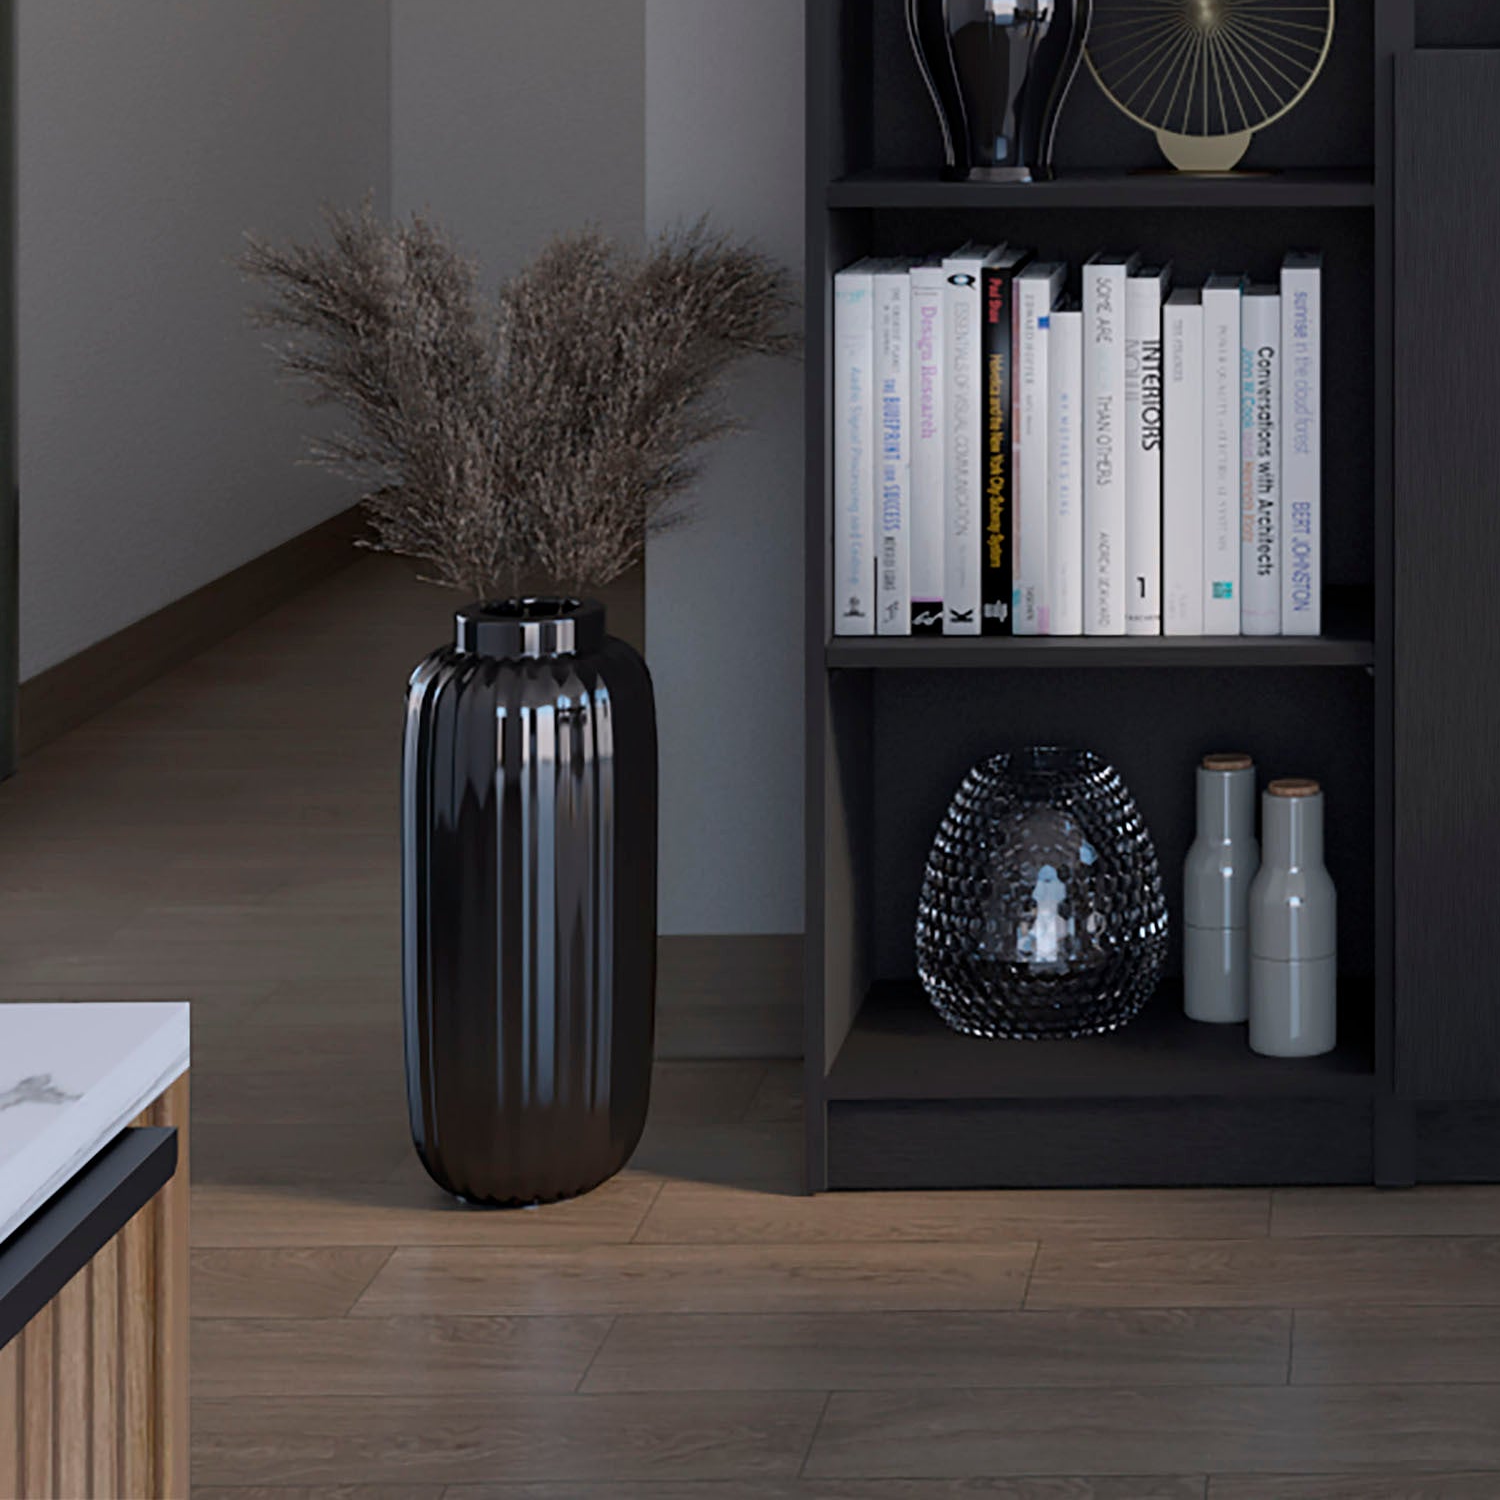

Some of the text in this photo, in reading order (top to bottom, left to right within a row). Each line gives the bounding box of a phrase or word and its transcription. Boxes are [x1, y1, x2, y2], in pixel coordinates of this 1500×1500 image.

[989, 278, 1002, 323] Paul Shaw
[1293, 291, 1307, 339] sunrise
[919, 306, 938, 439] Design Research
[953, 302, 970, 374] ESSENTIALS
[953, 377, 970, 393] OF
[953, 394, 970, 438] VISUAL
[1096, 277, 1112, 486] SOME ARE THAN OTHERS
[1142, 340, 1161, 451] INTERIORS
[883, 396, 901, 460] BLUEPRINT
[986, 354, 1003, 568] Helvetica and the New York City Subway System
[1256, 346, 1274, 576] Conversations with Architects
[883, 484, 901, 532] SUCCESS
[1291, 501, 1311, 612] BERT JOHNSTON
